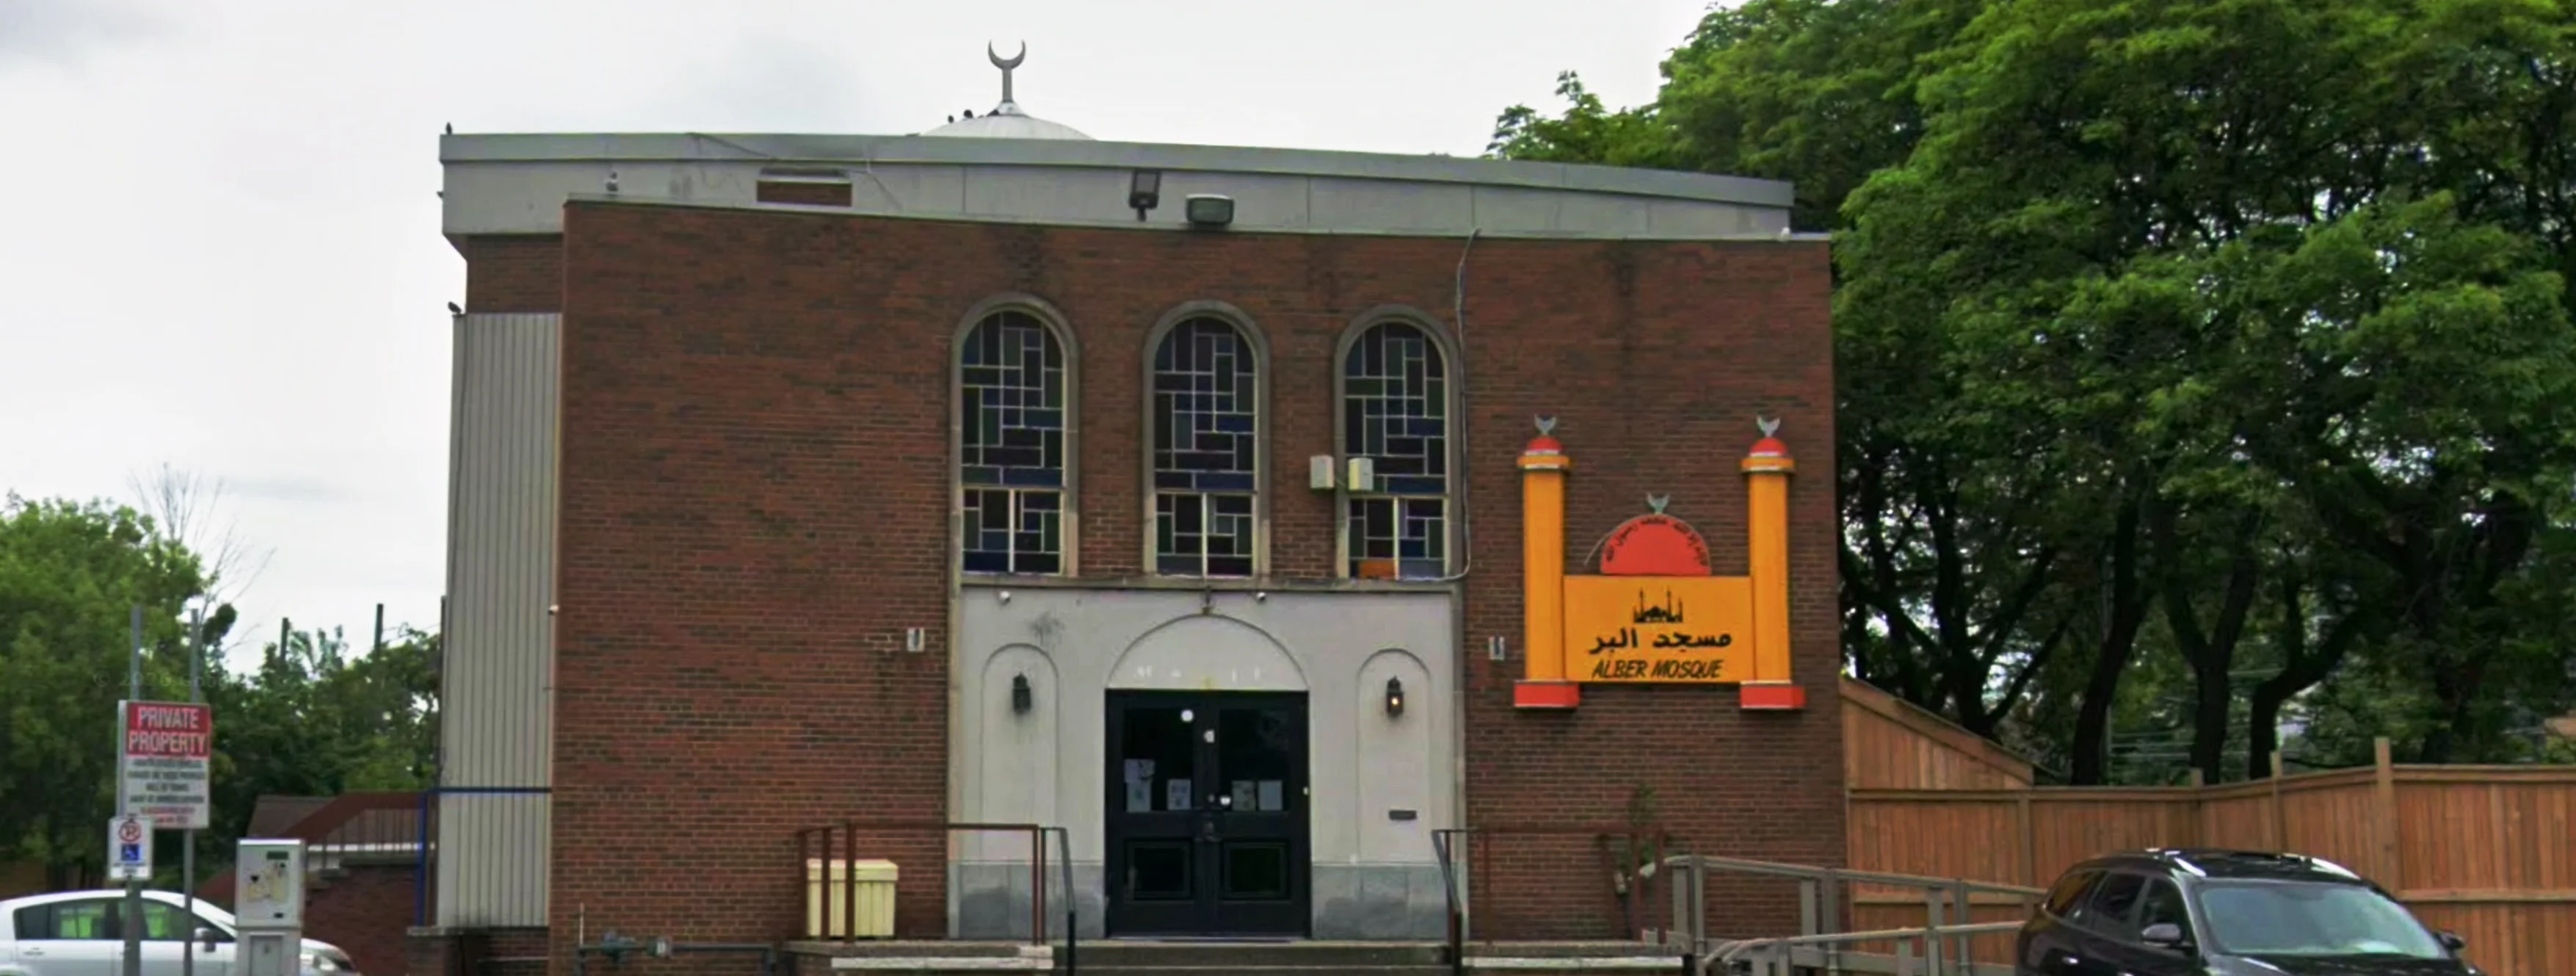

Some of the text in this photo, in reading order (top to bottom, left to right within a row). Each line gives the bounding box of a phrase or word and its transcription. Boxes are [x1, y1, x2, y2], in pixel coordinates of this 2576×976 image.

[1589, 628, 1733, 655] مسجد البر
[1592, 659, 1724, 679] ALBER MOSQUE
[137, 706, 200, 729] PRIVATE
[128, 731, 206, 753] PROPERTY
